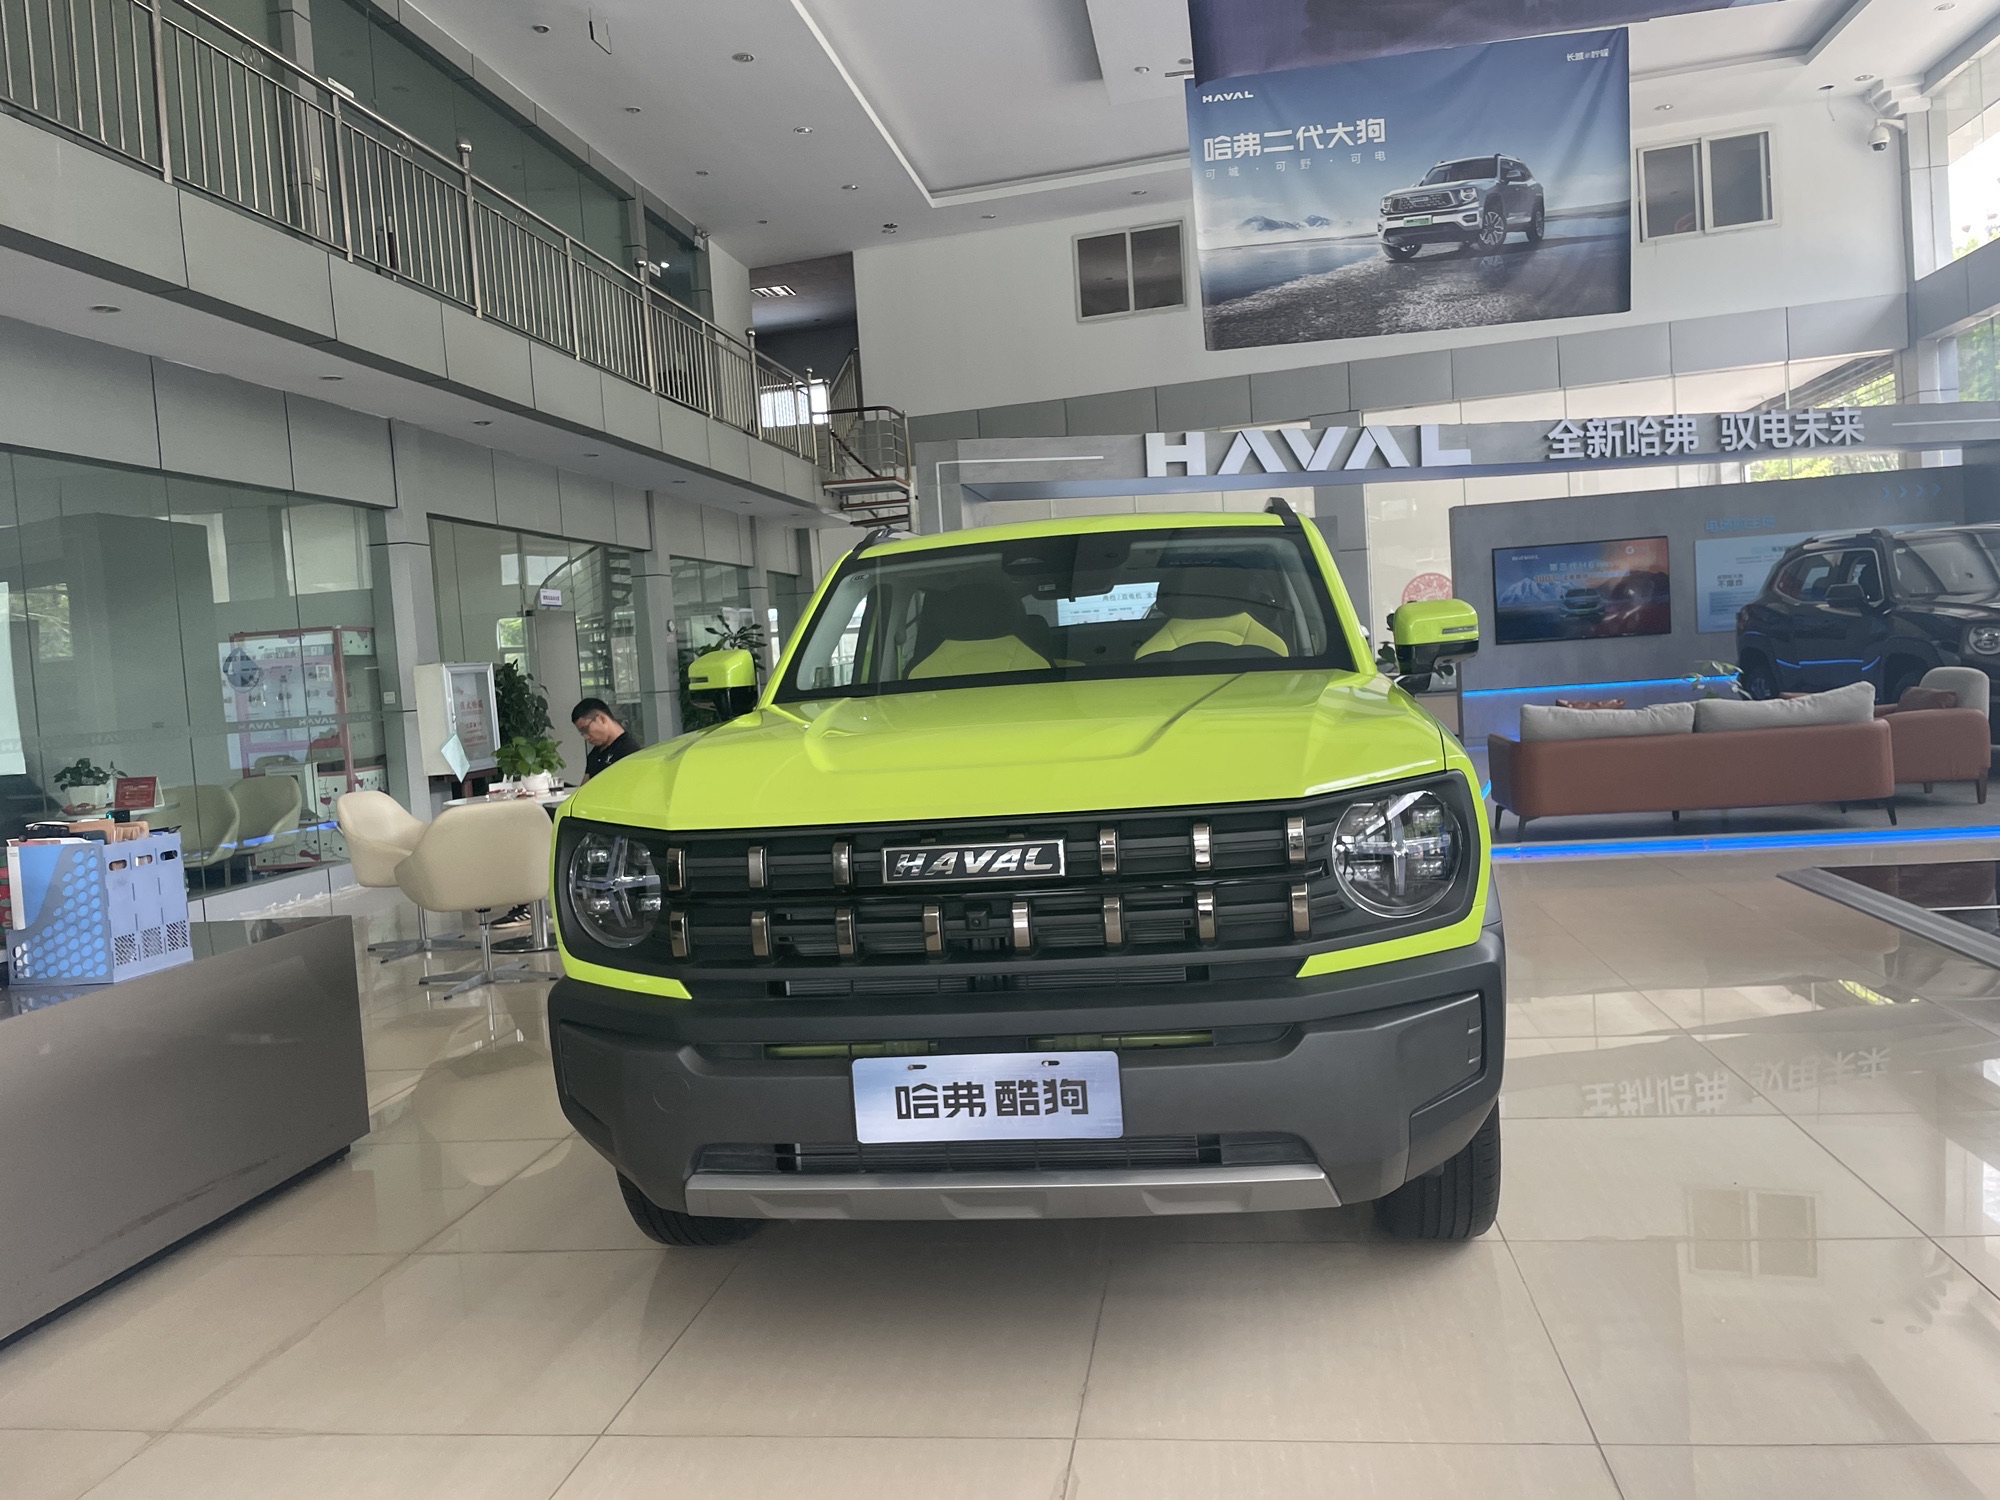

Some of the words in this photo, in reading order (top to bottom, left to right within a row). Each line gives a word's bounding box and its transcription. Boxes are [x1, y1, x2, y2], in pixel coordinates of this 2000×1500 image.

[1202, 90, 1254, 103] HAVAL
[1203, 118, 1386, 162] 哈弗二代大狗
[1145, 424, 1472, 477] HAVAL
[1547, 413, 1699, 460] 全新哈弗
[1720, 407, 1866, 451] 驭电未来
[299, 717, 336, 727] HAVAL
[893, 847, 1053, 877] HAVAL
[895, 1081, 986, 1120] 哈弗
[994, 1078, 1089, 1117] 酷狗
